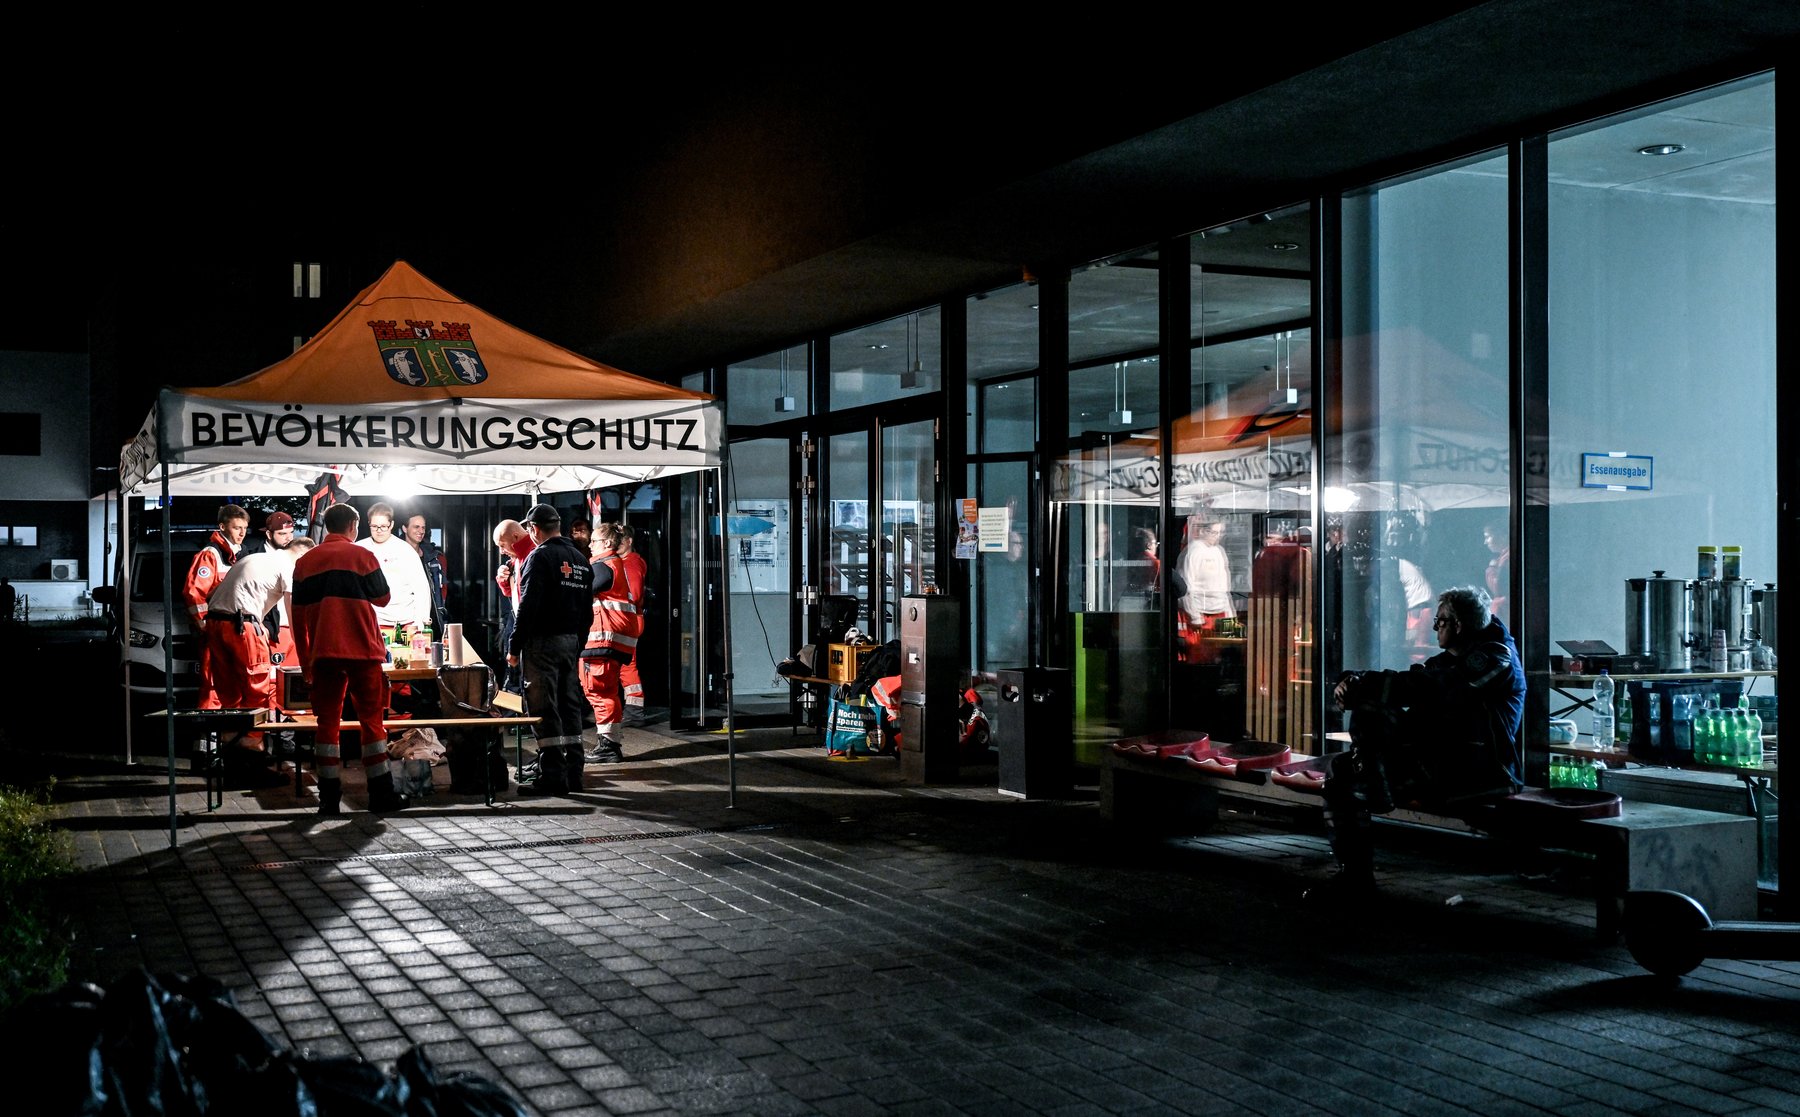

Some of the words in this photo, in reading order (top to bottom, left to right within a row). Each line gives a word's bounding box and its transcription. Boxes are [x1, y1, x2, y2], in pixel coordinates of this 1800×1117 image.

[191, 404, 699, 450] BEVÖLKERUNGSSCHUTZ
[1590, 464, 1647, 478] Essenausgabe
[838, 709, 857, 719] Noch
